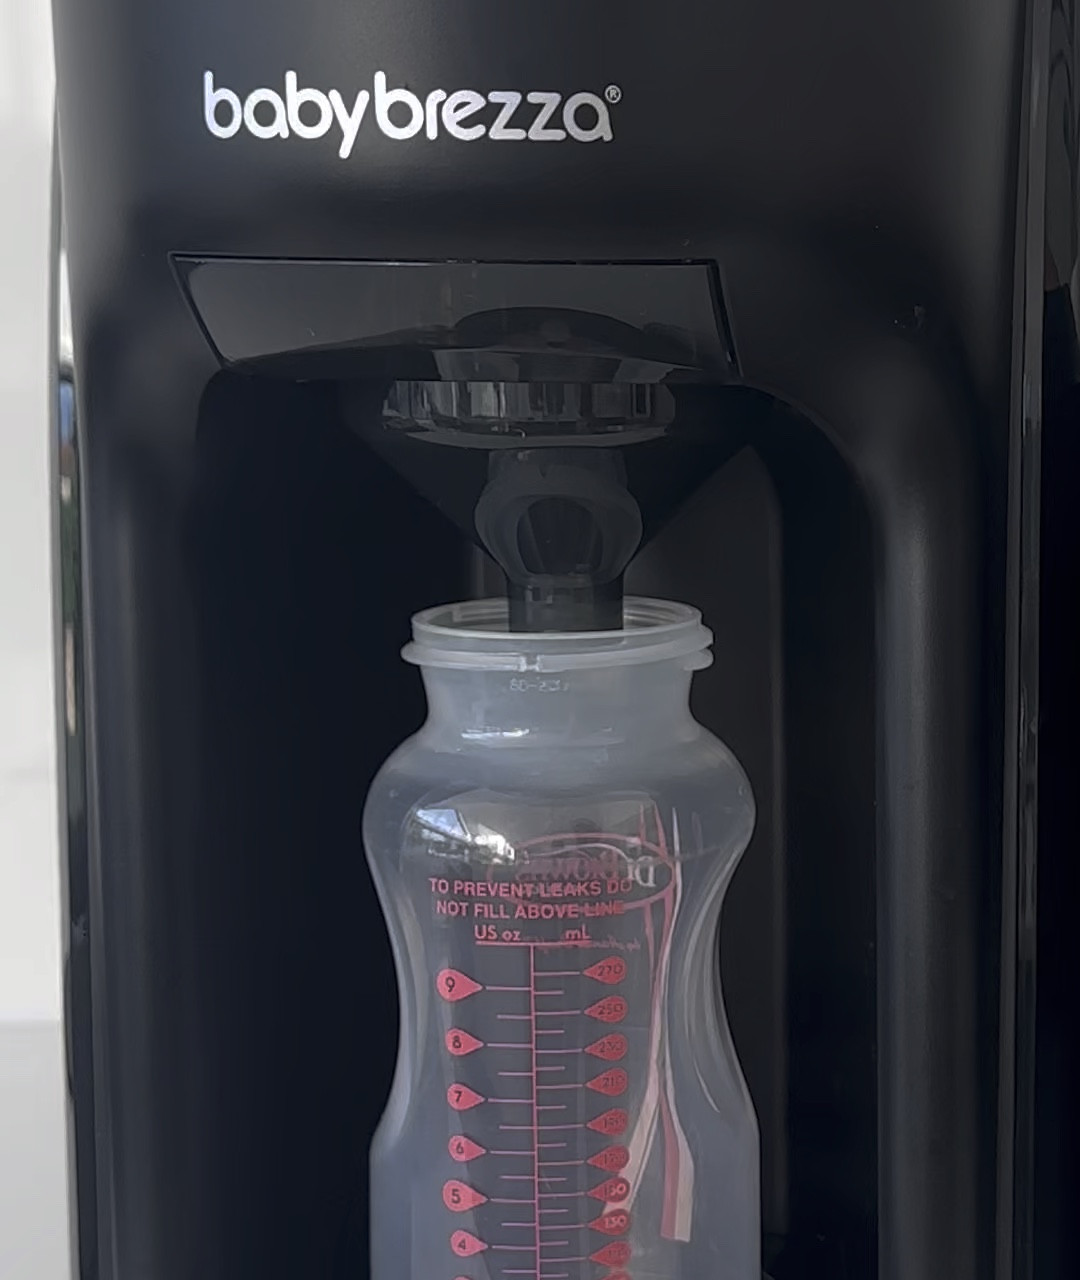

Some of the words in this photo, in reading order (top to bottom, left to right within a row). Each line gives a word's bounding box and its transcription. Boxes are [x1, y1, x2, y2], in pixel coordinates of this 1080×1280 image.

[428, 878, 449, 895] TO
[453, 880, 534, 898] PREVENT
[540, 881, 602, 898] LEAKS
[436, 901, 469, 918] NOT
[473, 902, 510, 919] FILL
[514, 902, 580, 919] ABOVE
[583, 900, 627, 917] LINE
[474, 925, 498, 940] US
[501, 930, 521, 942] oz
[444, 977, 456, 994] 9
[451, 1035, 463, 1049] 8
[453, 1091, 463, 1104] 7
[455, 1141, 465, 1155] 6
[450, 1188, 462, 1205] 5
